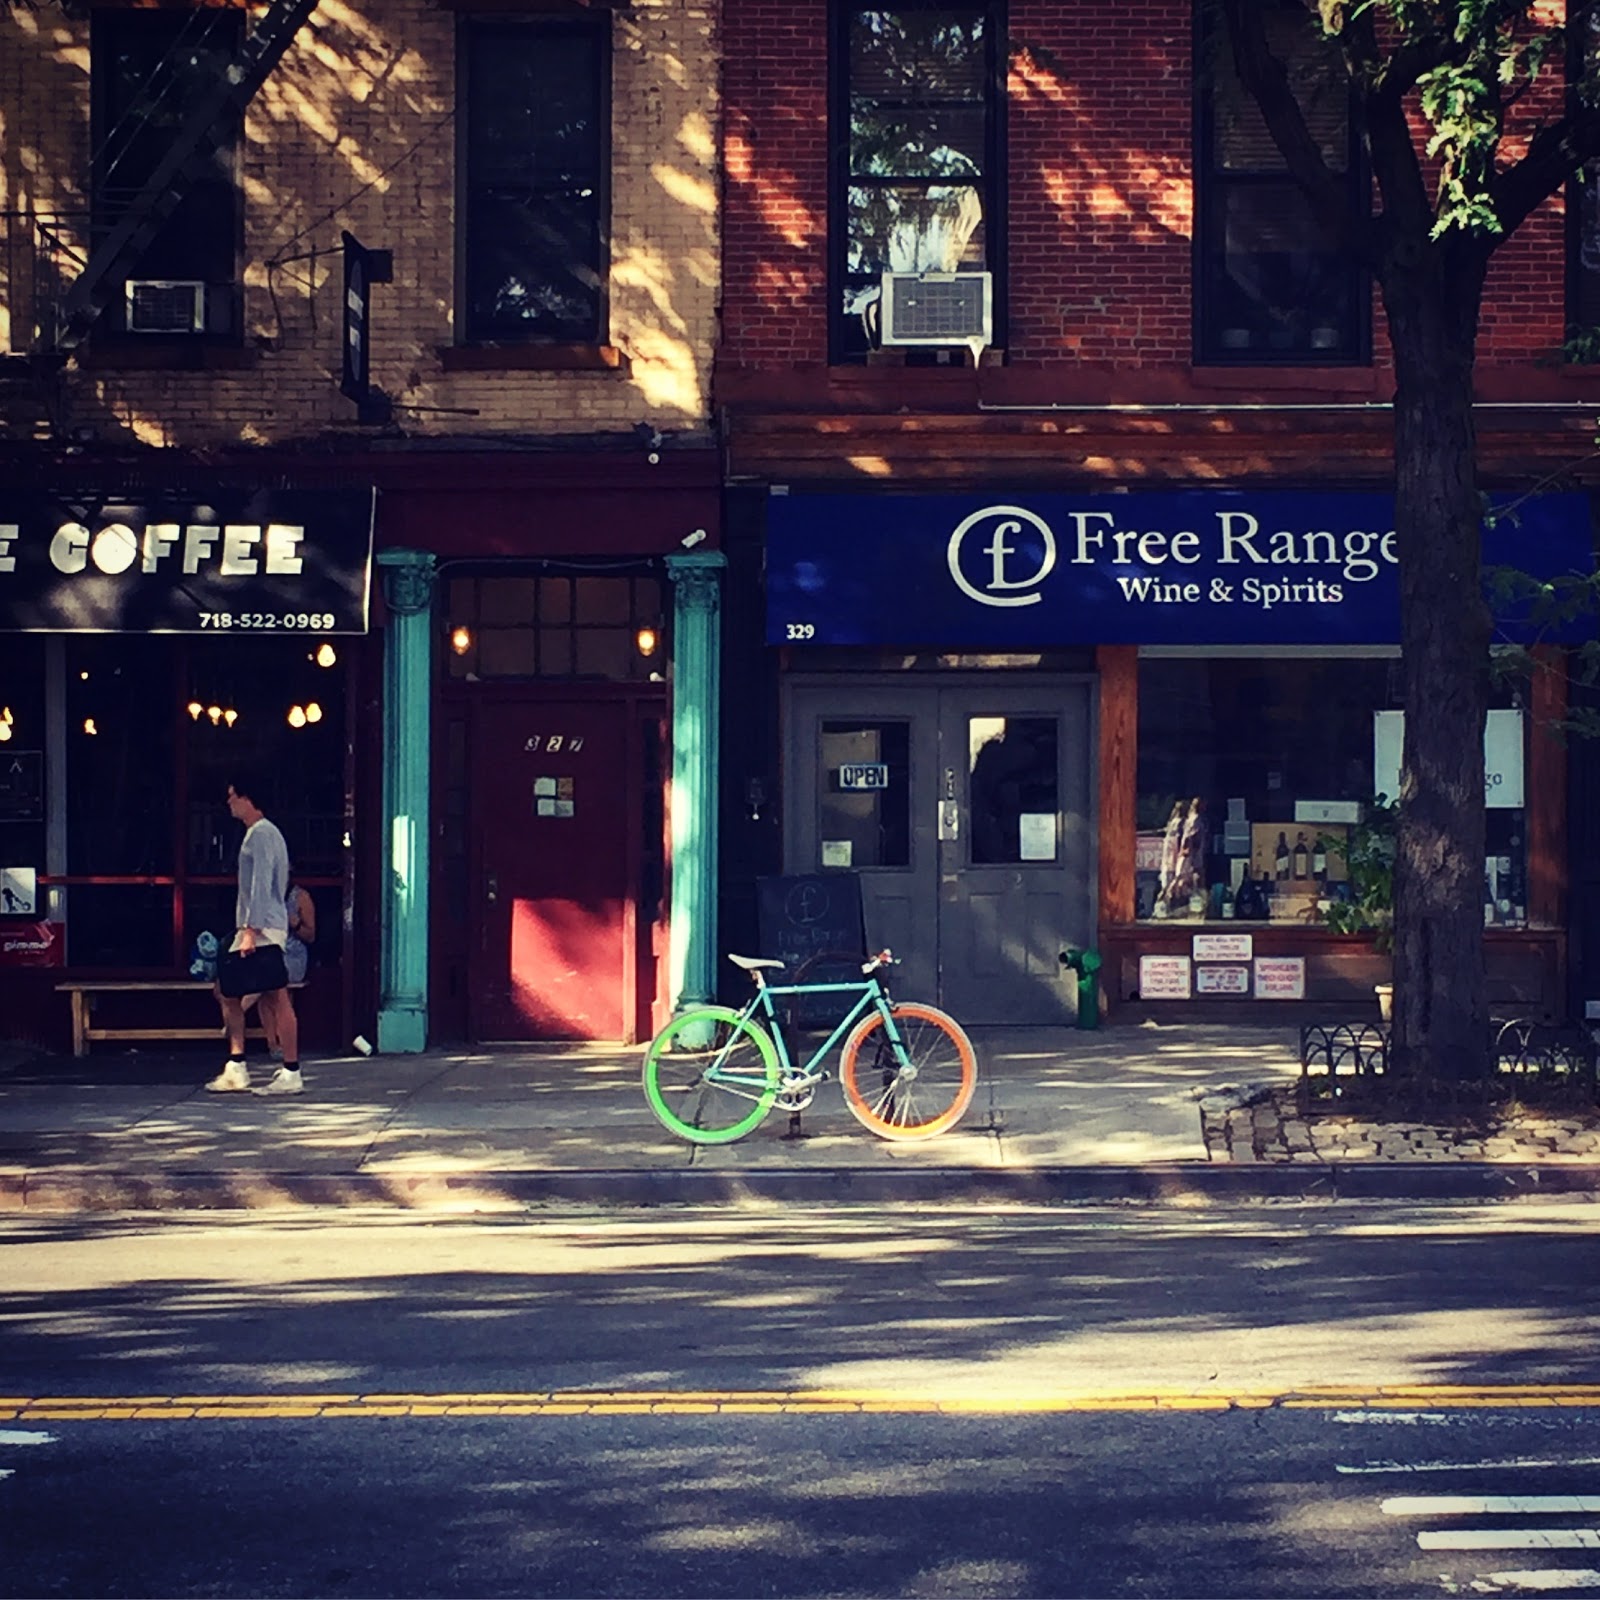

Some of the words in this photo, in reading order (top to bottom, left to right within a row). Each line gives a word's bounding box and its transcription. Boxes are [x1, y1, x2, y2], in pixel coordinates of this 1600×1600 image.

[50, 523, 304, 575] COFFEE
[1068, 512, 1201, 564] Free
[1215, 512, 1399, 582] Range
[1116, 577, 1201, 603] Wine
[1208, 577, 1234, 603] &
[1242, 575, 1344, 609] Spirits
[198, 612, 336, 629] 718-522-0969
[786, 624, 815, 640] 329
[843, 766, 885, 786] OPEN
